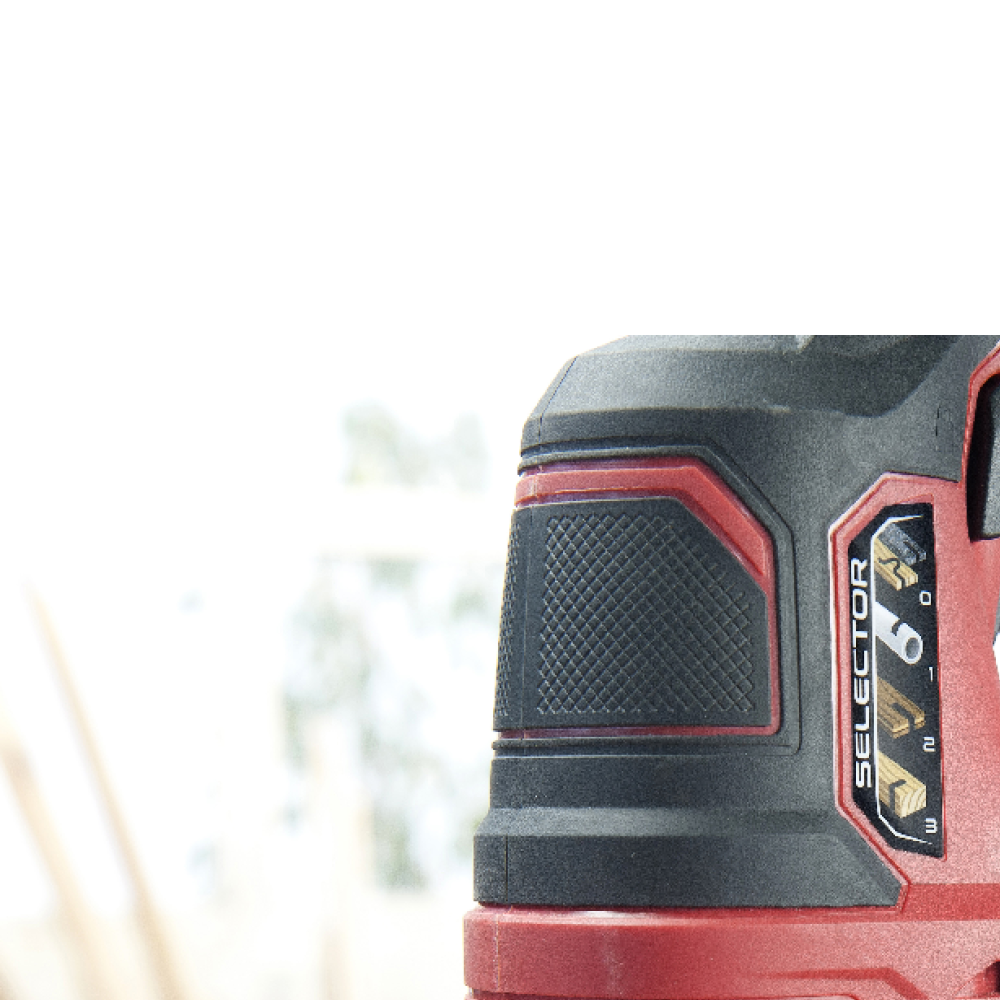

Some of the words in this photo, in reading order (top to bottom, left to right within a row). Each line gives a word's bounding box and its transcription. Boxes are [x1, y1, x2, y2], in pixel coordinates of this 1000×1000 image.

[850, 557, 871, 788] SELECTOR
[923, 736, 935, 752] 2
[925, 817, 937, 833] 3
